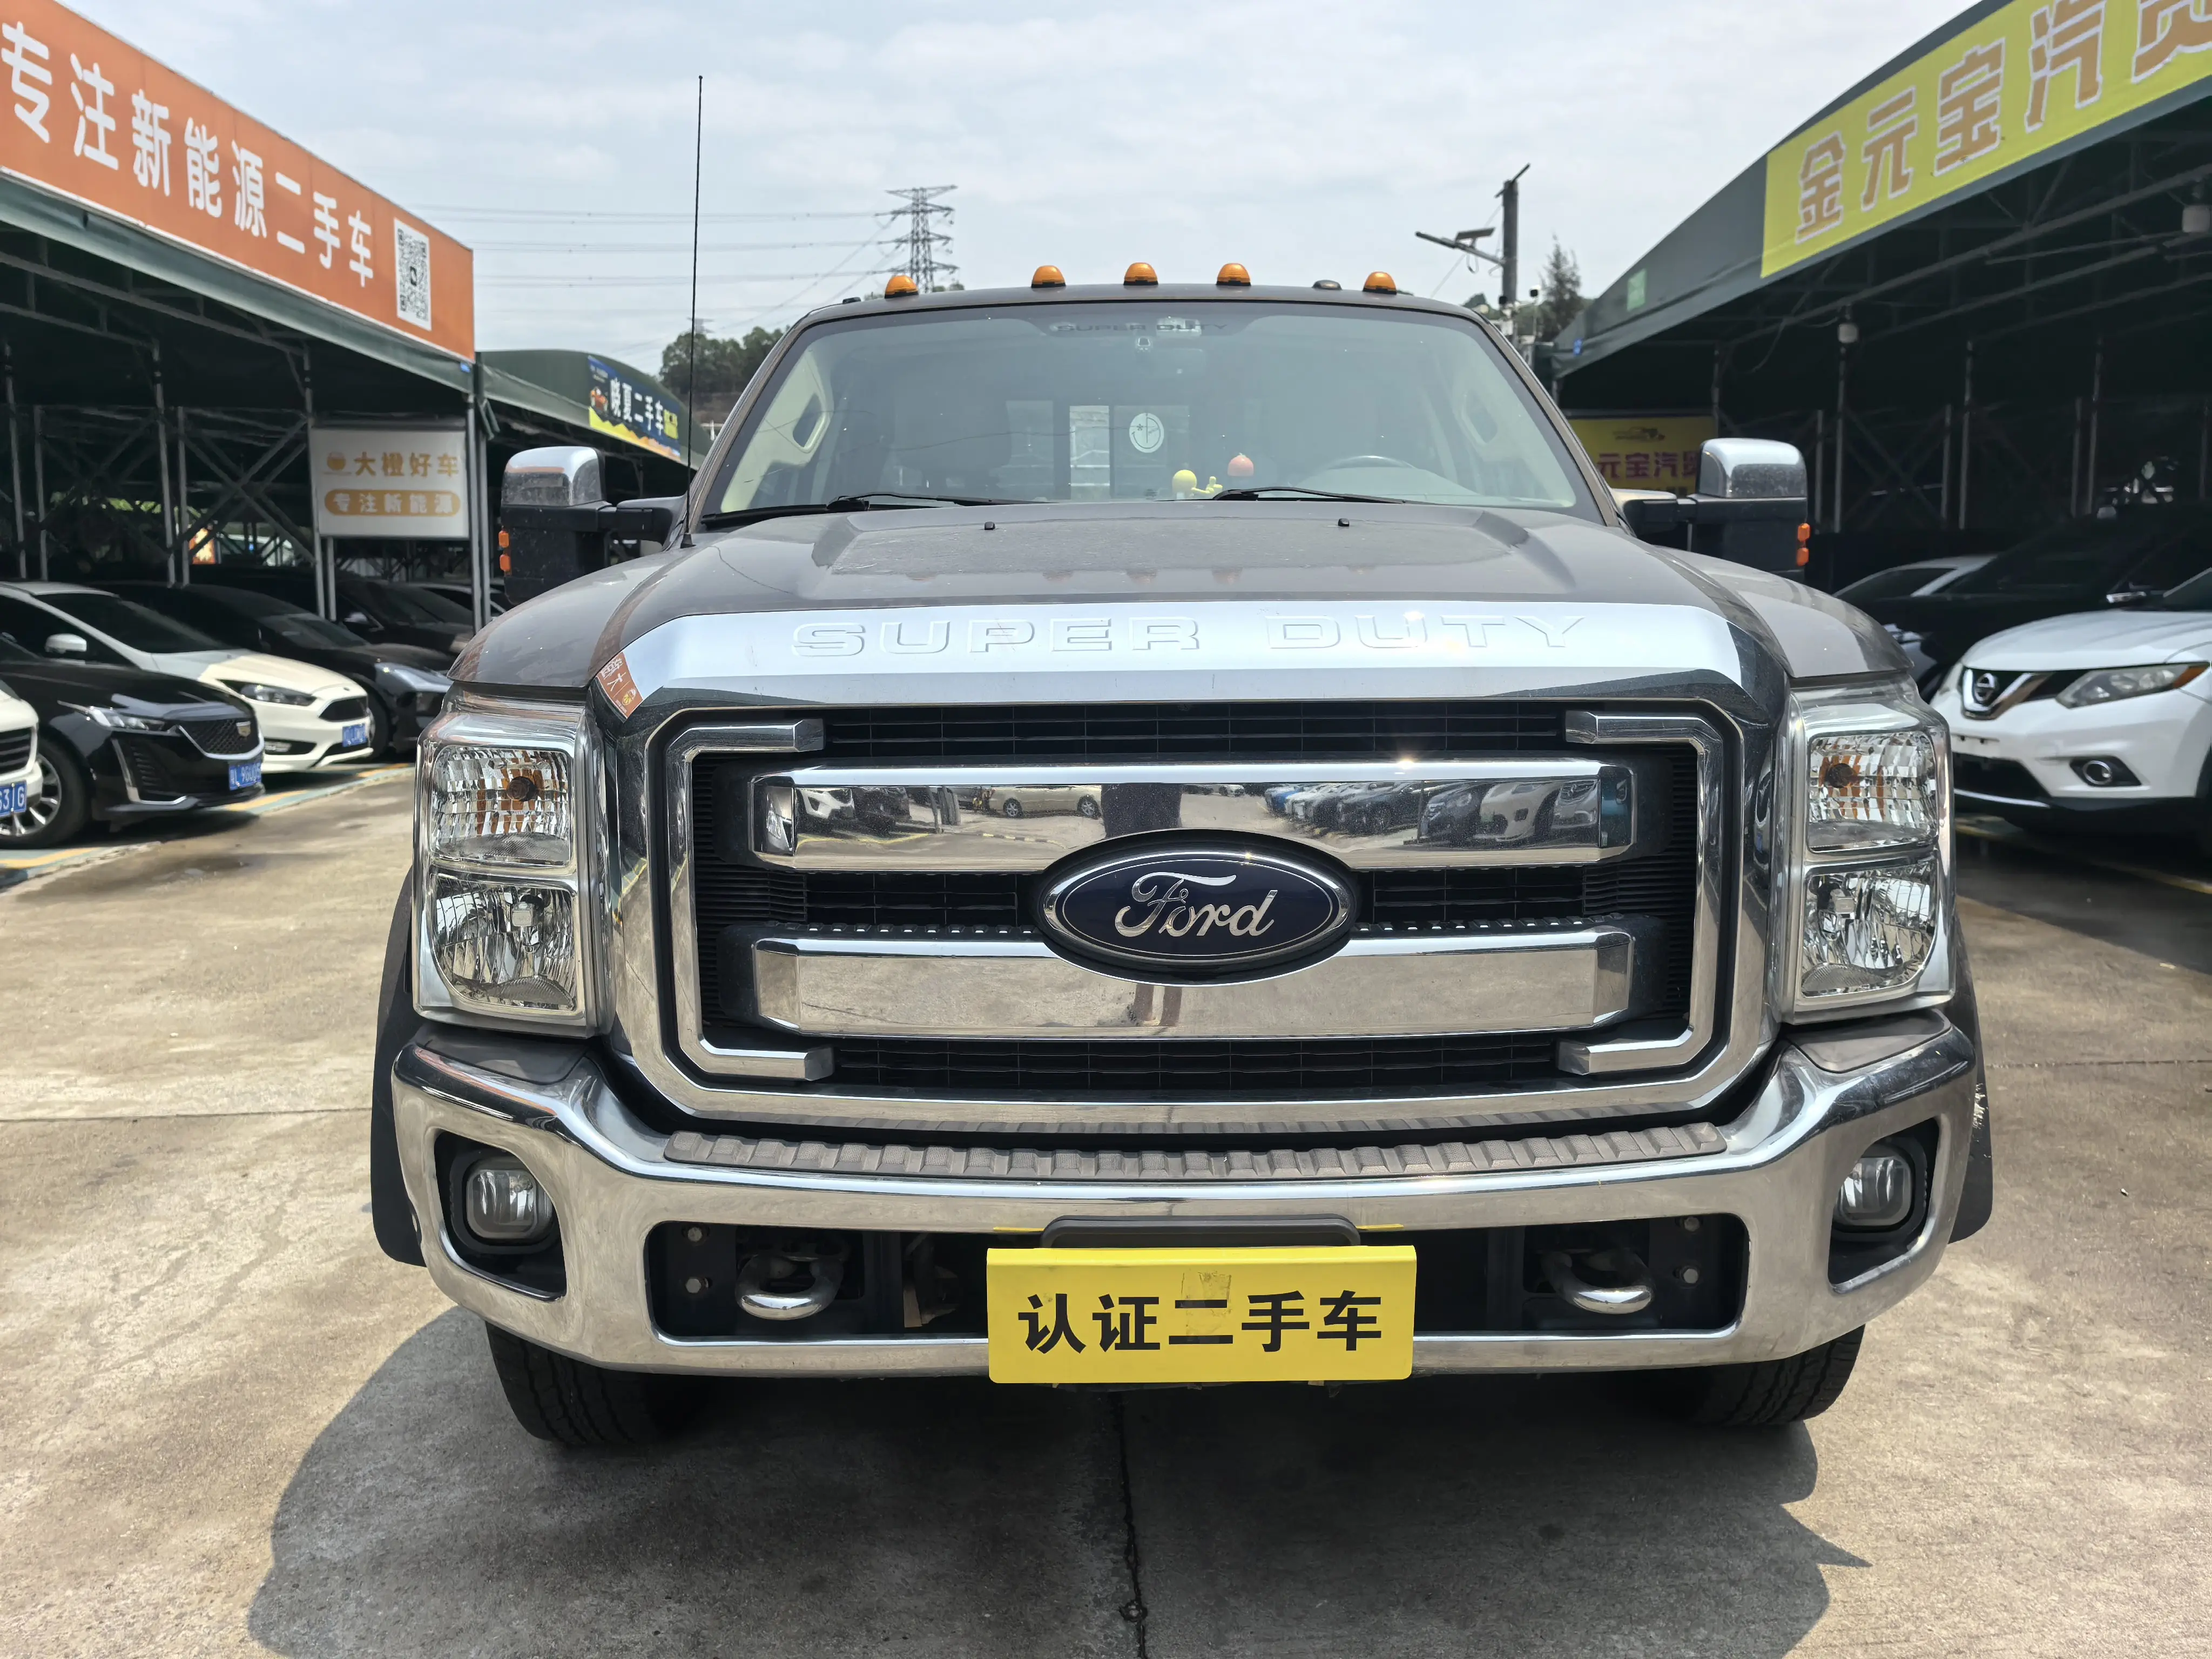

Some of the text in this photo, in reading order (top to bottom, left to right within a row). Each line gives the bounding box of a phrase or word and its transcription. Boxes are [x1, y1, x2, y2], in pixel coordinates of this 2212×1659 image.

[1, 22, 374, 287] 专注新能源二手车
[354, 451, 459, 477] 大橙好车
[792, 615, 1587, 657] SUPER DUTY
[1115, 871, 1278, 937] Ford
[1017, 1290, 1382, 1354] 认证二手车
